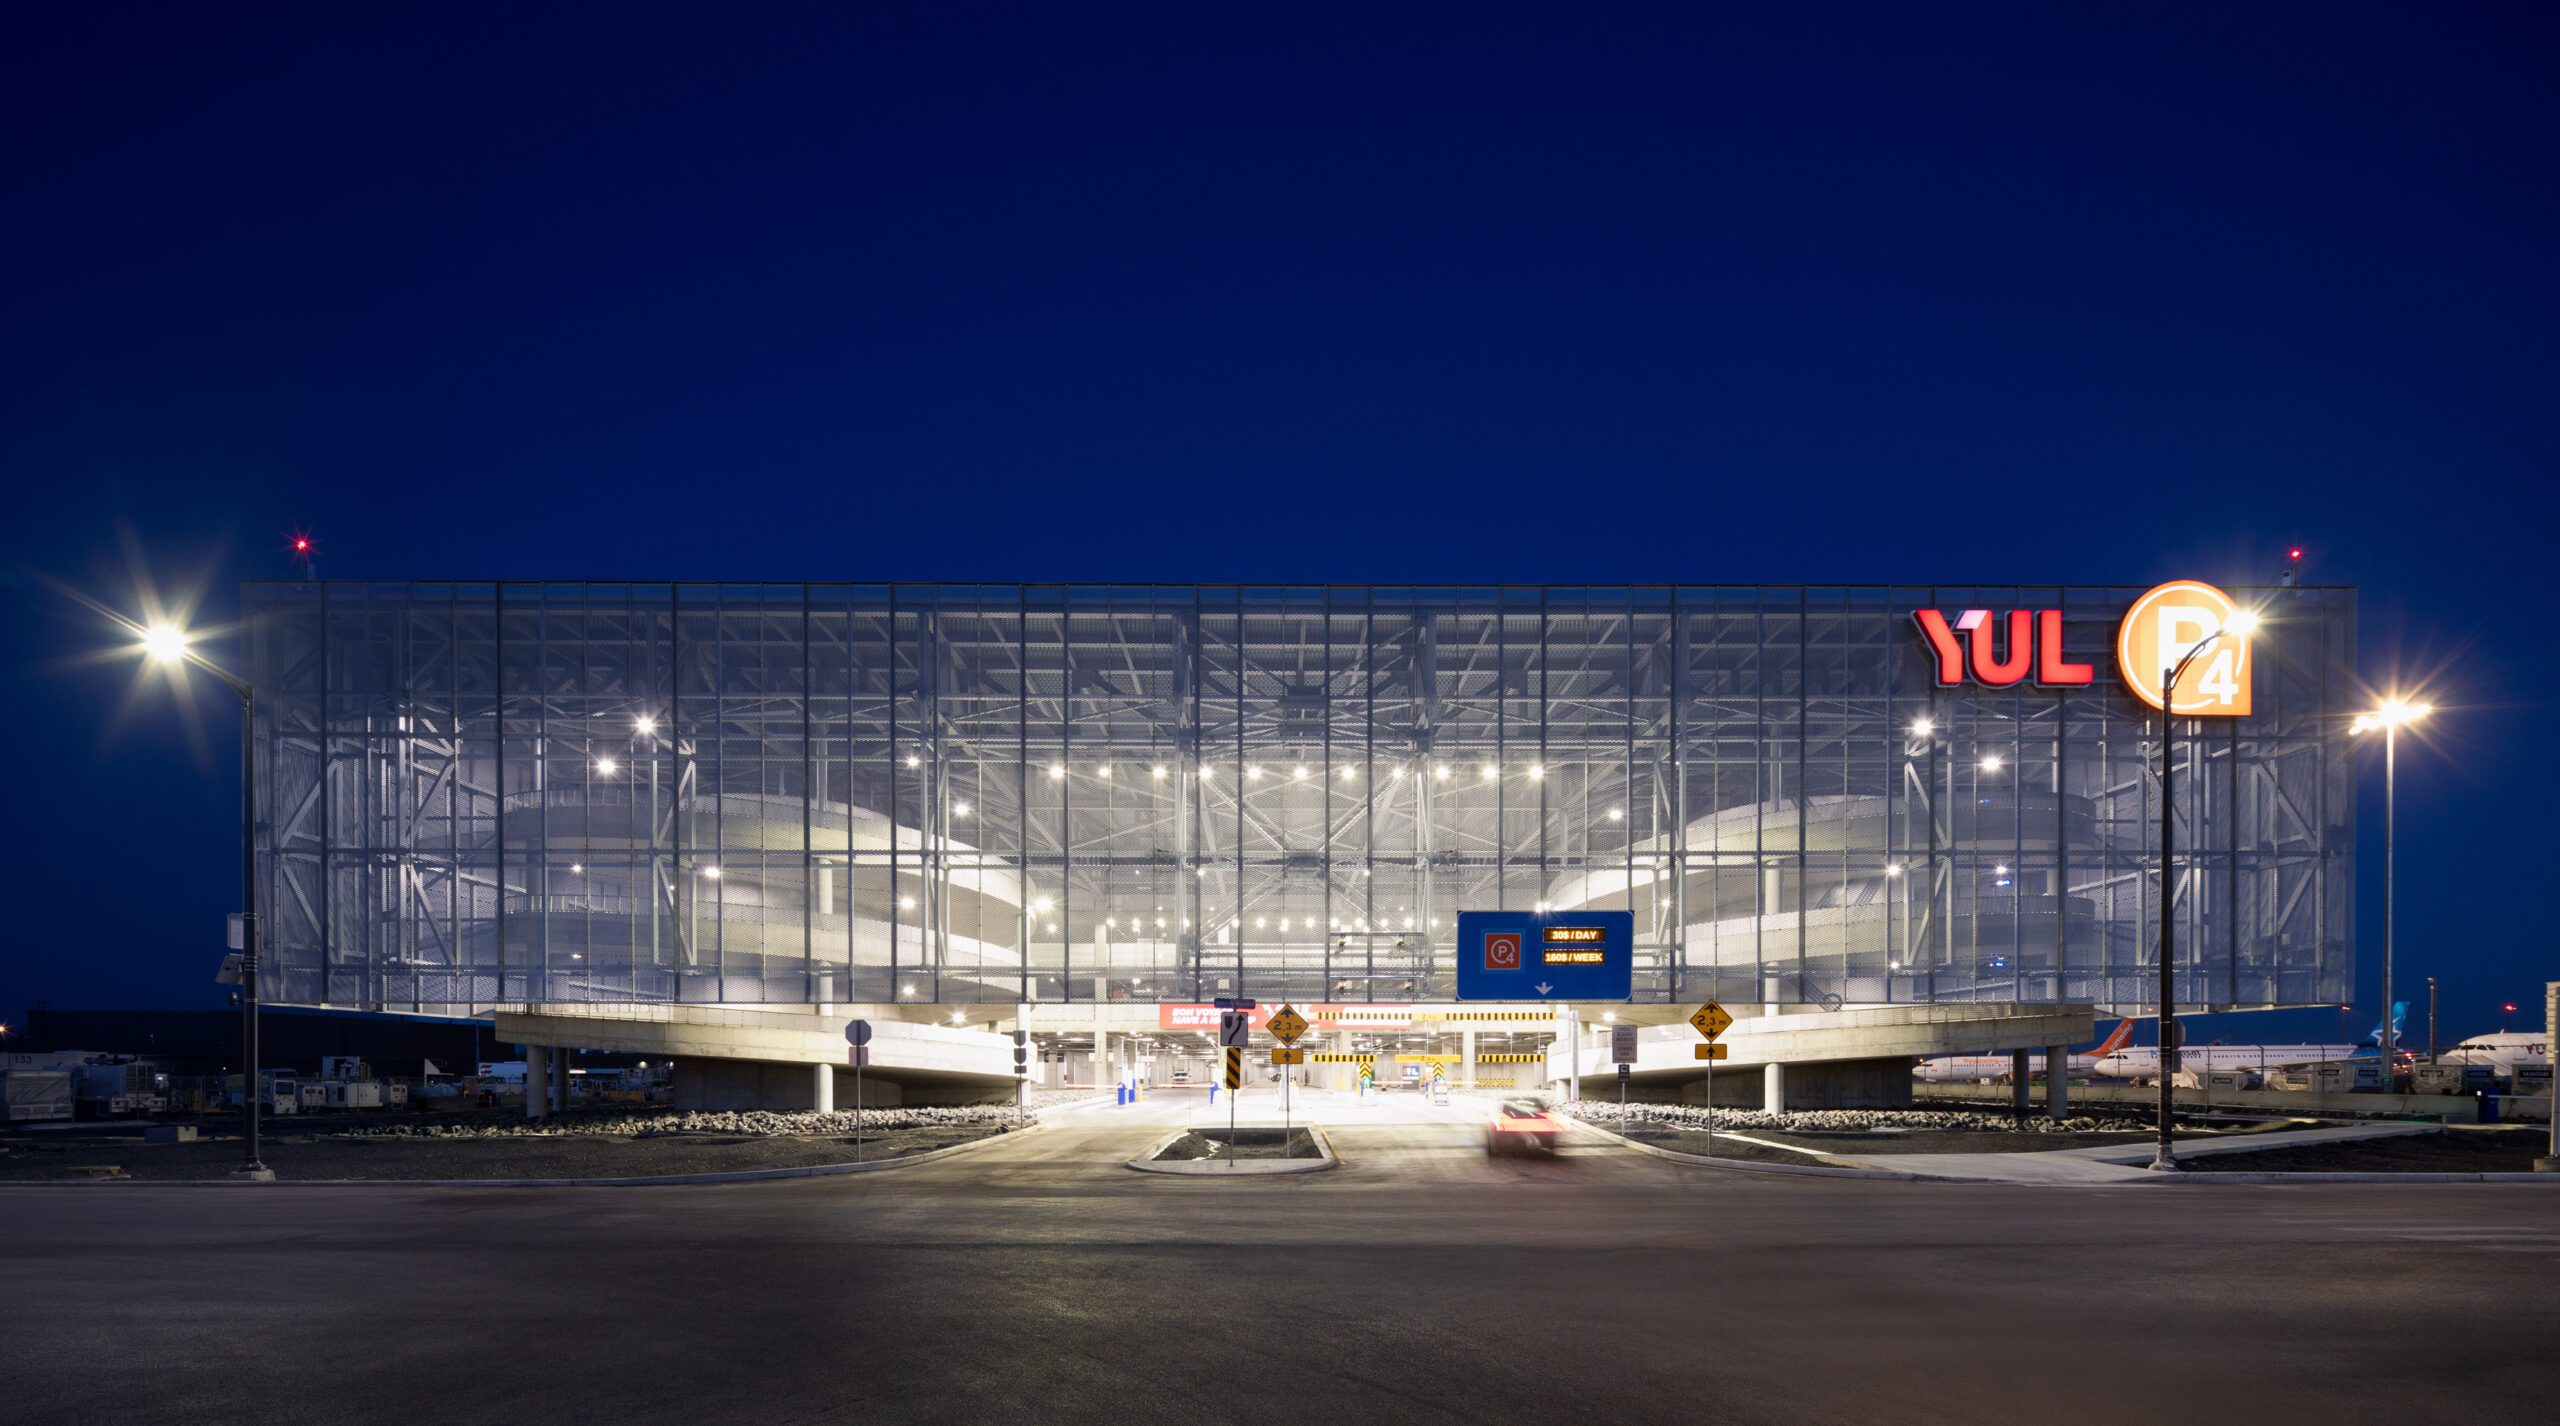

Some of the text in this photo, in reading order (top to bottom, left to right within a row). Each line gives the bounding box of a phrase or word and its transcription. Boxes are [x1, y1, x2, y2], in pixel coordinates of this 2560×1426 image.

[1913, 609, 2093, 687] YUL
[1552, 931, 1569, 940] 30$
[1575, 931, 1597, 940] DAY
[1545, 953, 1567, 962] 160$
[1573, 953, 1603, 962] WEEK
